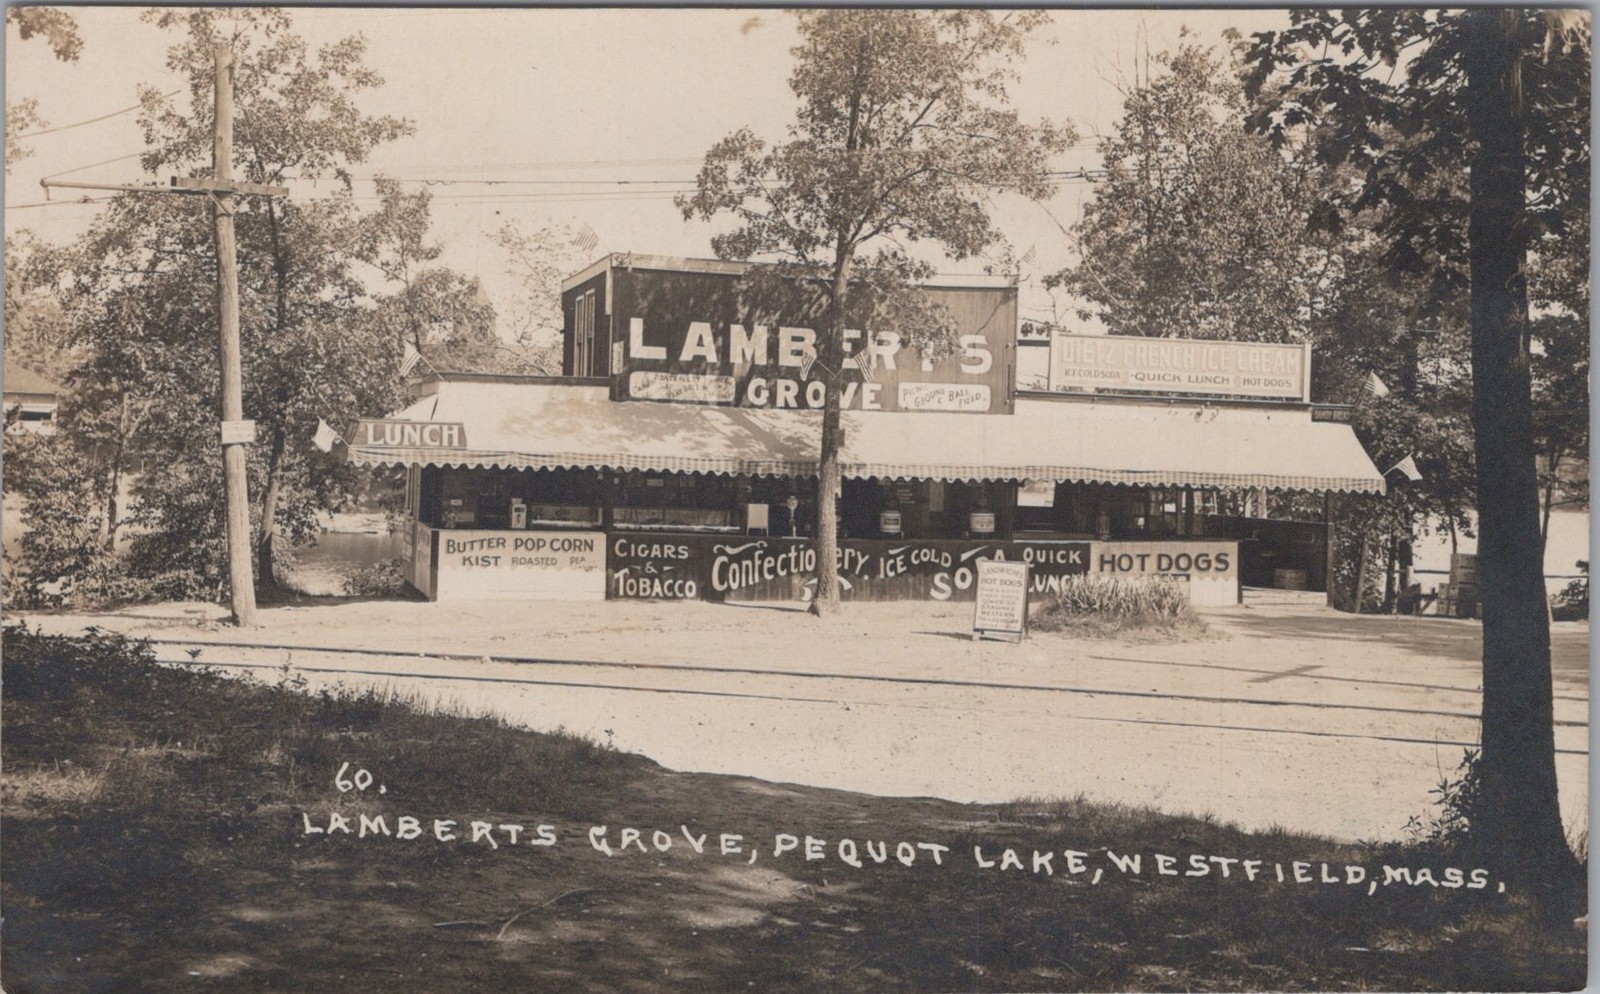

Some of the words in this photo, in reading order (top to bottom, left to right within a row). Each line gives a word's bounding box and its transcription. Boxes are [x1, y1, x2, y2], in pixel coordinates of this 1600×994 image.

[1061, 339, 1115, 364] DIETZ
[1122, 343, 1198, 369] FRENCH
[1202, 346, 1230, 370] ICE
[1236, 348, 1298, 374] CREAM
[1078, 369, 1101, 378] COLD
[1101, 371, 1121, 379] SODA
[1135, 372, 1181, 383] QUICK
[1188, 374, 1230, 385] LUNCH
[1243, 378, 1262, 387] HOT
[1264, 378, 1292, 388] DOGS
[747, 378, 882, 409] GROVE
[914, 388, 945, 407] GROUND
[949, 388, 969, 401] BALL
[367, 423, 460, 446] LUNCH
[445, 538, 506, 554] BUTTER
[514, 538, 546, 551] POP
[550, 538, 594, 552] CORN
[615, 538, 689, 559] CIGARS
[462, 556, 501, 567] KIST
[511, 556, 558, 566] ROASTED
[879, 555, 907, 579] ICE
[911, 548, 952, 569] COLD
[1023, 547, 1082, 568] QUICK
[1100, 553, 1150, 572] HOT
[1157, 553, 1230, 572] DOGS
[644, 562, 658, 574] &
[712, 544, 870, 592] Confectioery.
[614, 568, 697, 598] TOBACCO
[1000, 579, 1023, 587] DOGS
